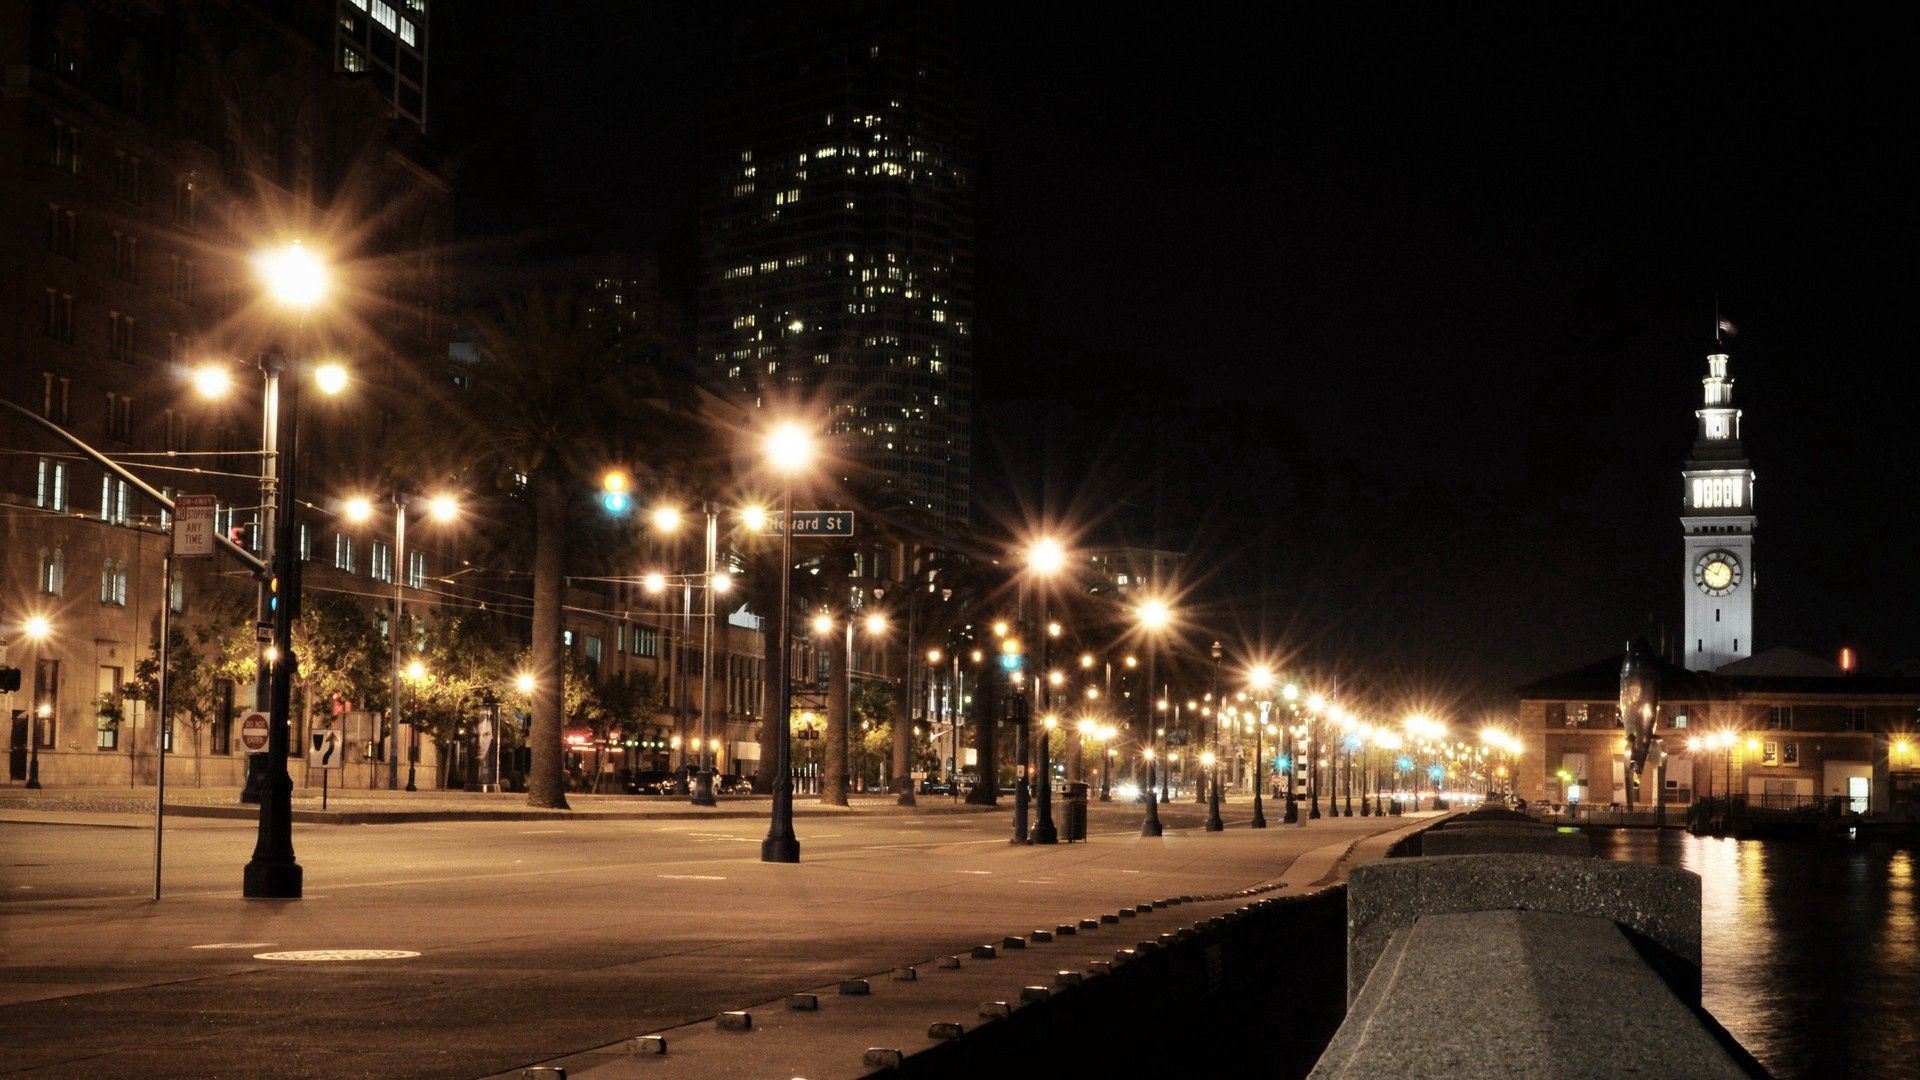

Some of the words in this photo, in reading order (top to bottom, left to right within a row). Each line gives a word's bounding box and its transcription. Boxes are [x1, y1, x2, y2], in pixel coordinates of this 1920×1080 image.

[175, 508, 186, 520] NO
[187, 508, 213, 520] STOPPING
[186, 522, 202, 532] ANY
[826, 517, 842, 530] St
[185, 534, 203, 545] TIME
[246, 720, 254, 728] DO
[255, 720, 266, 728] NOT
[246, 736, 264, 744] ENTER
